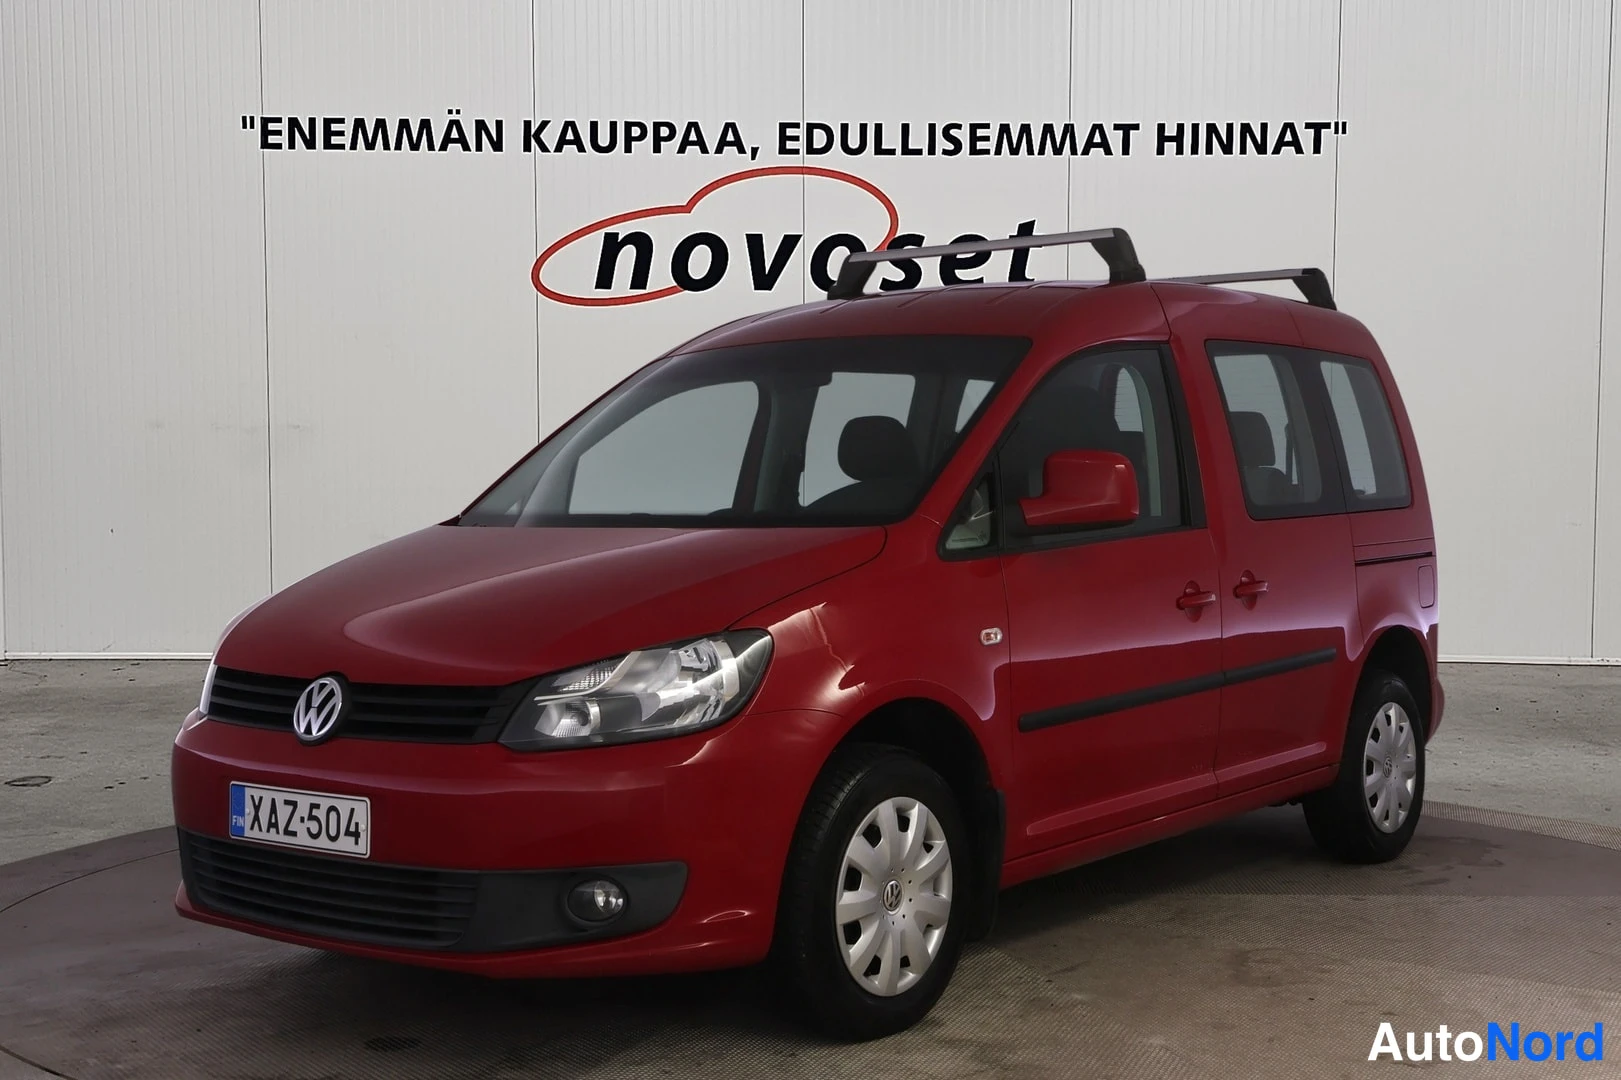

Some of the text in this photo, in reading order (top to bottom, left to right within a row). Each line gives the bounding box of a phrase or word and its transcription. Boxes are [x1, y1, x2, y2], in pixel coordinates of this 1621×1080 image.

[241, 108, 1347, 161] "ENEMMÄN KAUPPAA, EDULLISEMMAT HINNAT"
[594, 219, 1042, 292] novoset
[232, 795, 361, 846] FIN XAZ-504
